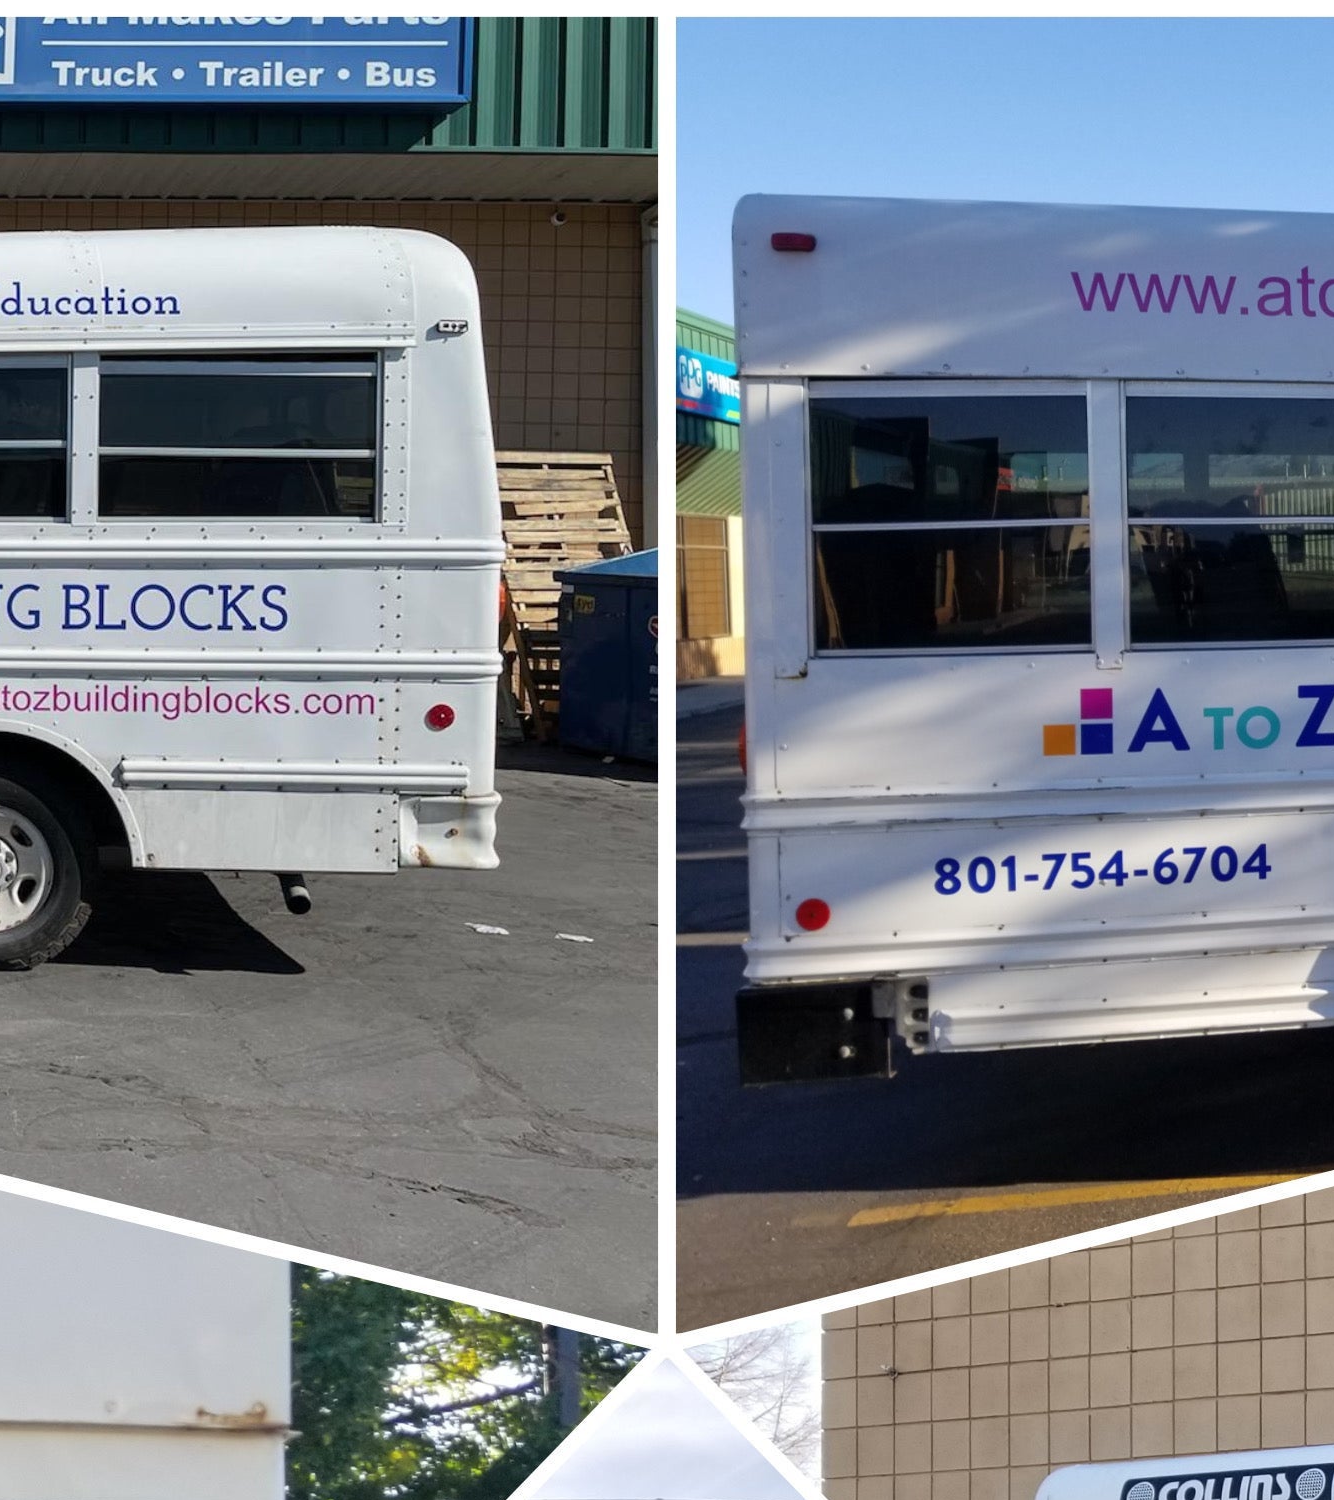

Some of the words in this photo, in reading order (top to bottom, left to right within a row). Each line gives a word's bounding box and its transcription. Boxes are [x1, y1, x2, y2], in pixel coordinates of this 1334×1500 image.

[51, 61, 157, 87] Truck
[199, 61, 324, 87] Trailer
[366, 61, 436, 87] Bus
[61, 584, 288, 632] BLOCKS
[1128, 687, 1190, 752] A
[934, 843, 1272, 895] 801-754-6704
